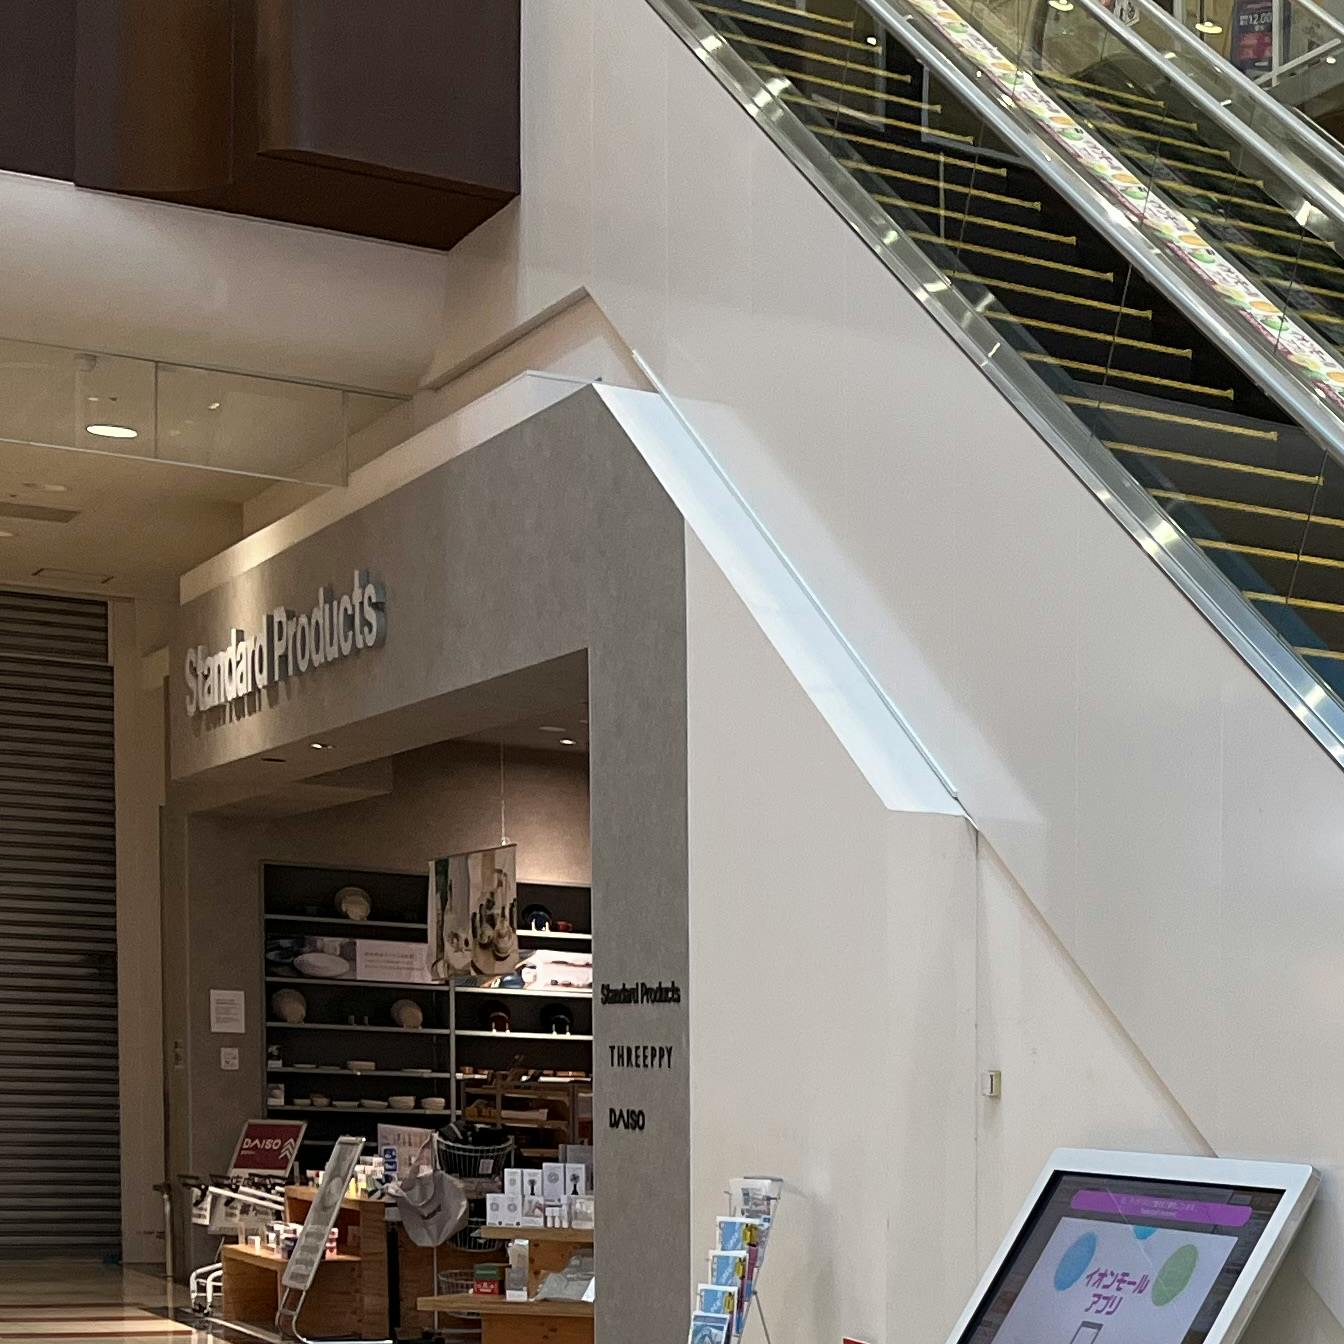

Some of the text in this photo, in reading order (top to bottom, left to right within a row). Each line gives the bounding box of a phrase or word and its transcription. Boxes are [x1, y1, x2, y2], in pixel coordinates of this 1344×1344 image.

[184, 568, 380, 717] Standard Products
[600, 980, 681, 1005] Standard Products
[608, 1045, 673, 1069] THREEPPY
[608, 1107, 646, 1131] DAISO
[242, 1137, 282, 1151] DAISO
[1085, 1266, 1150, 1295] イオンモール
[1083, 1293, 1124, 1316] アプリ
